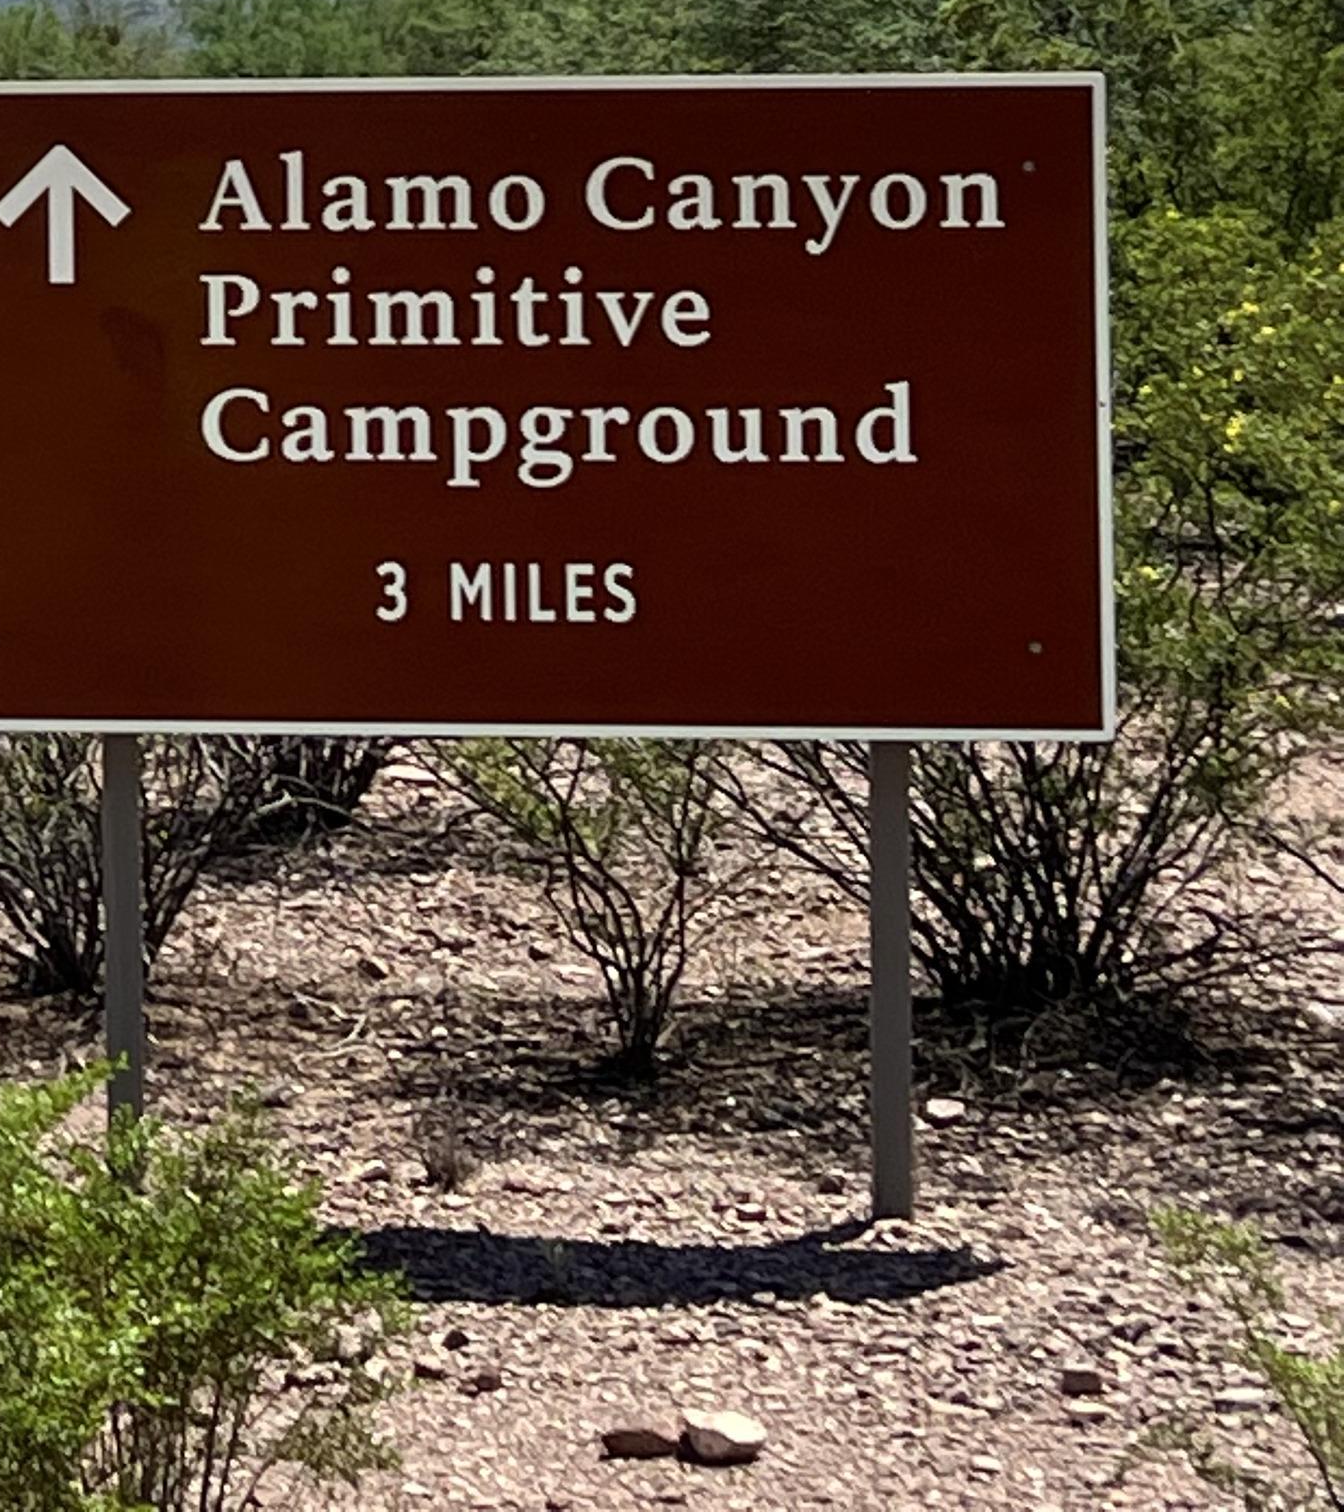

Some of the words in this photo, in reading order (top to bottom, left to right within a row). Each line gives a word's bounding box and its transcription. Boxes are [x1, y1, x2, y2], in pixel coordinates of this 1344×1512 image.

[199, 150, 544, 231] Alamo
[586, 157, 1005, 255] Canyon
[199, 266, 711, 347] Primitive
[202, 380, 918, 488] Campground
[376, 561, 407, 621] 3
[450, 562, 636, 623] MILES
